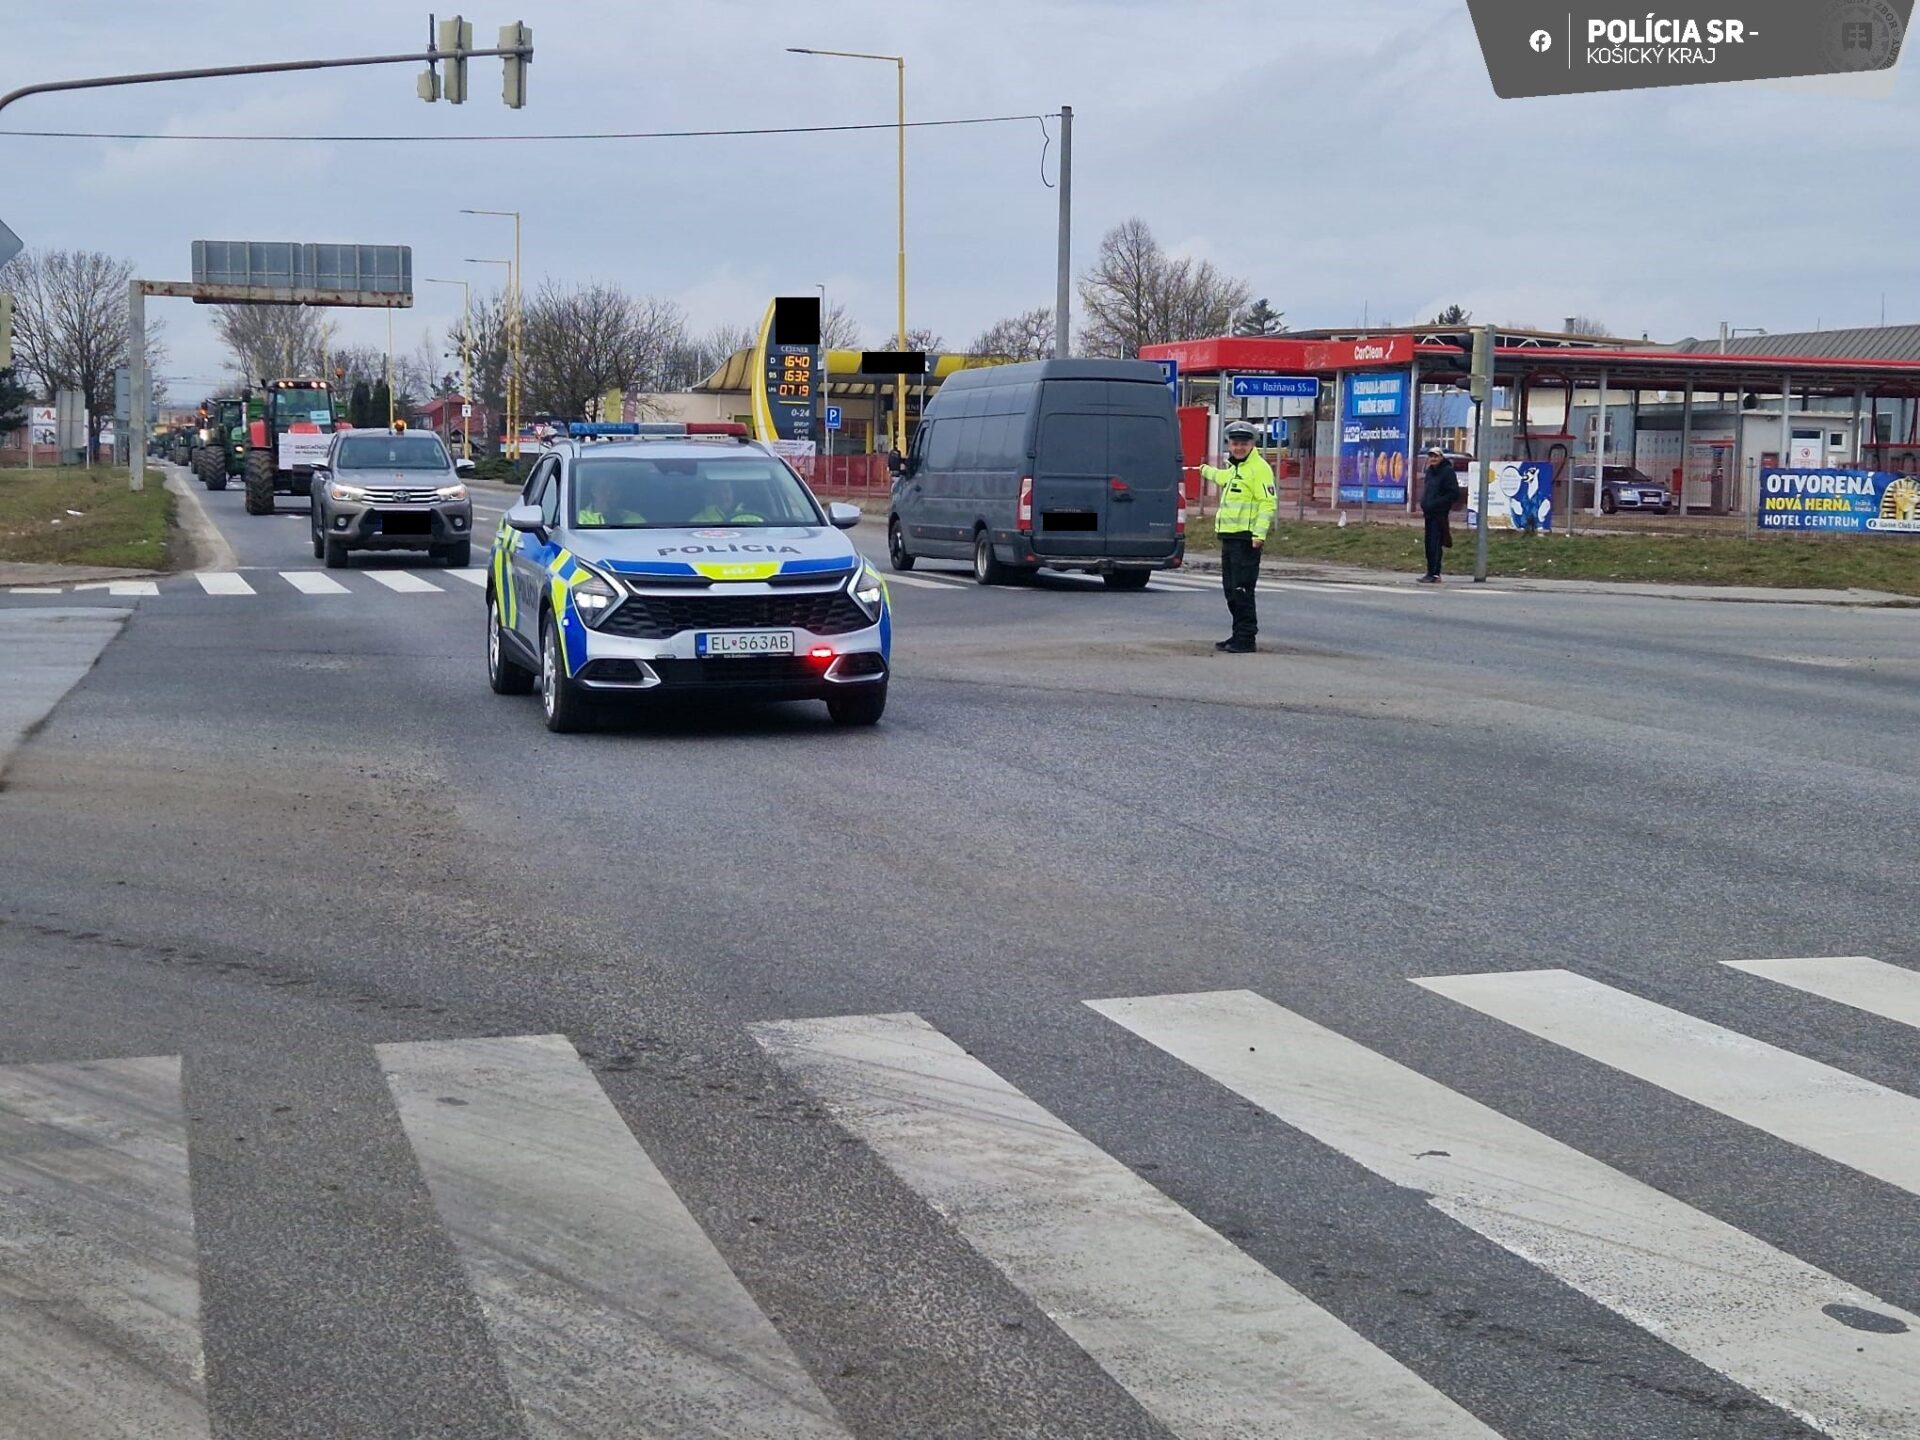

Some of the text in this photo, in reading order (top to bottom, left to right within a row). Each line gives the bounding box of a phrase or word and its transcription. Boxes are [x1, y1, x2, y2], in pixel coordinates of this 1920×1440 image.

[1263, 382, 1295, 392] Rožňava
[1297, 382, 1307, 392] 55
[791, 408, 810, 417] 0-24
[829, 409, 838, 421] P
[1766, 472, 1876, 496] OTVORENÁ
[1765, 494, 1852, 512] NOVÁ HERŇA
[1764, 514, 1859, 527] HOTEL CENTRUM
[657, 543, 802, 556] POLÍCIA
[711, 635, 789, 651] EL 563AB
